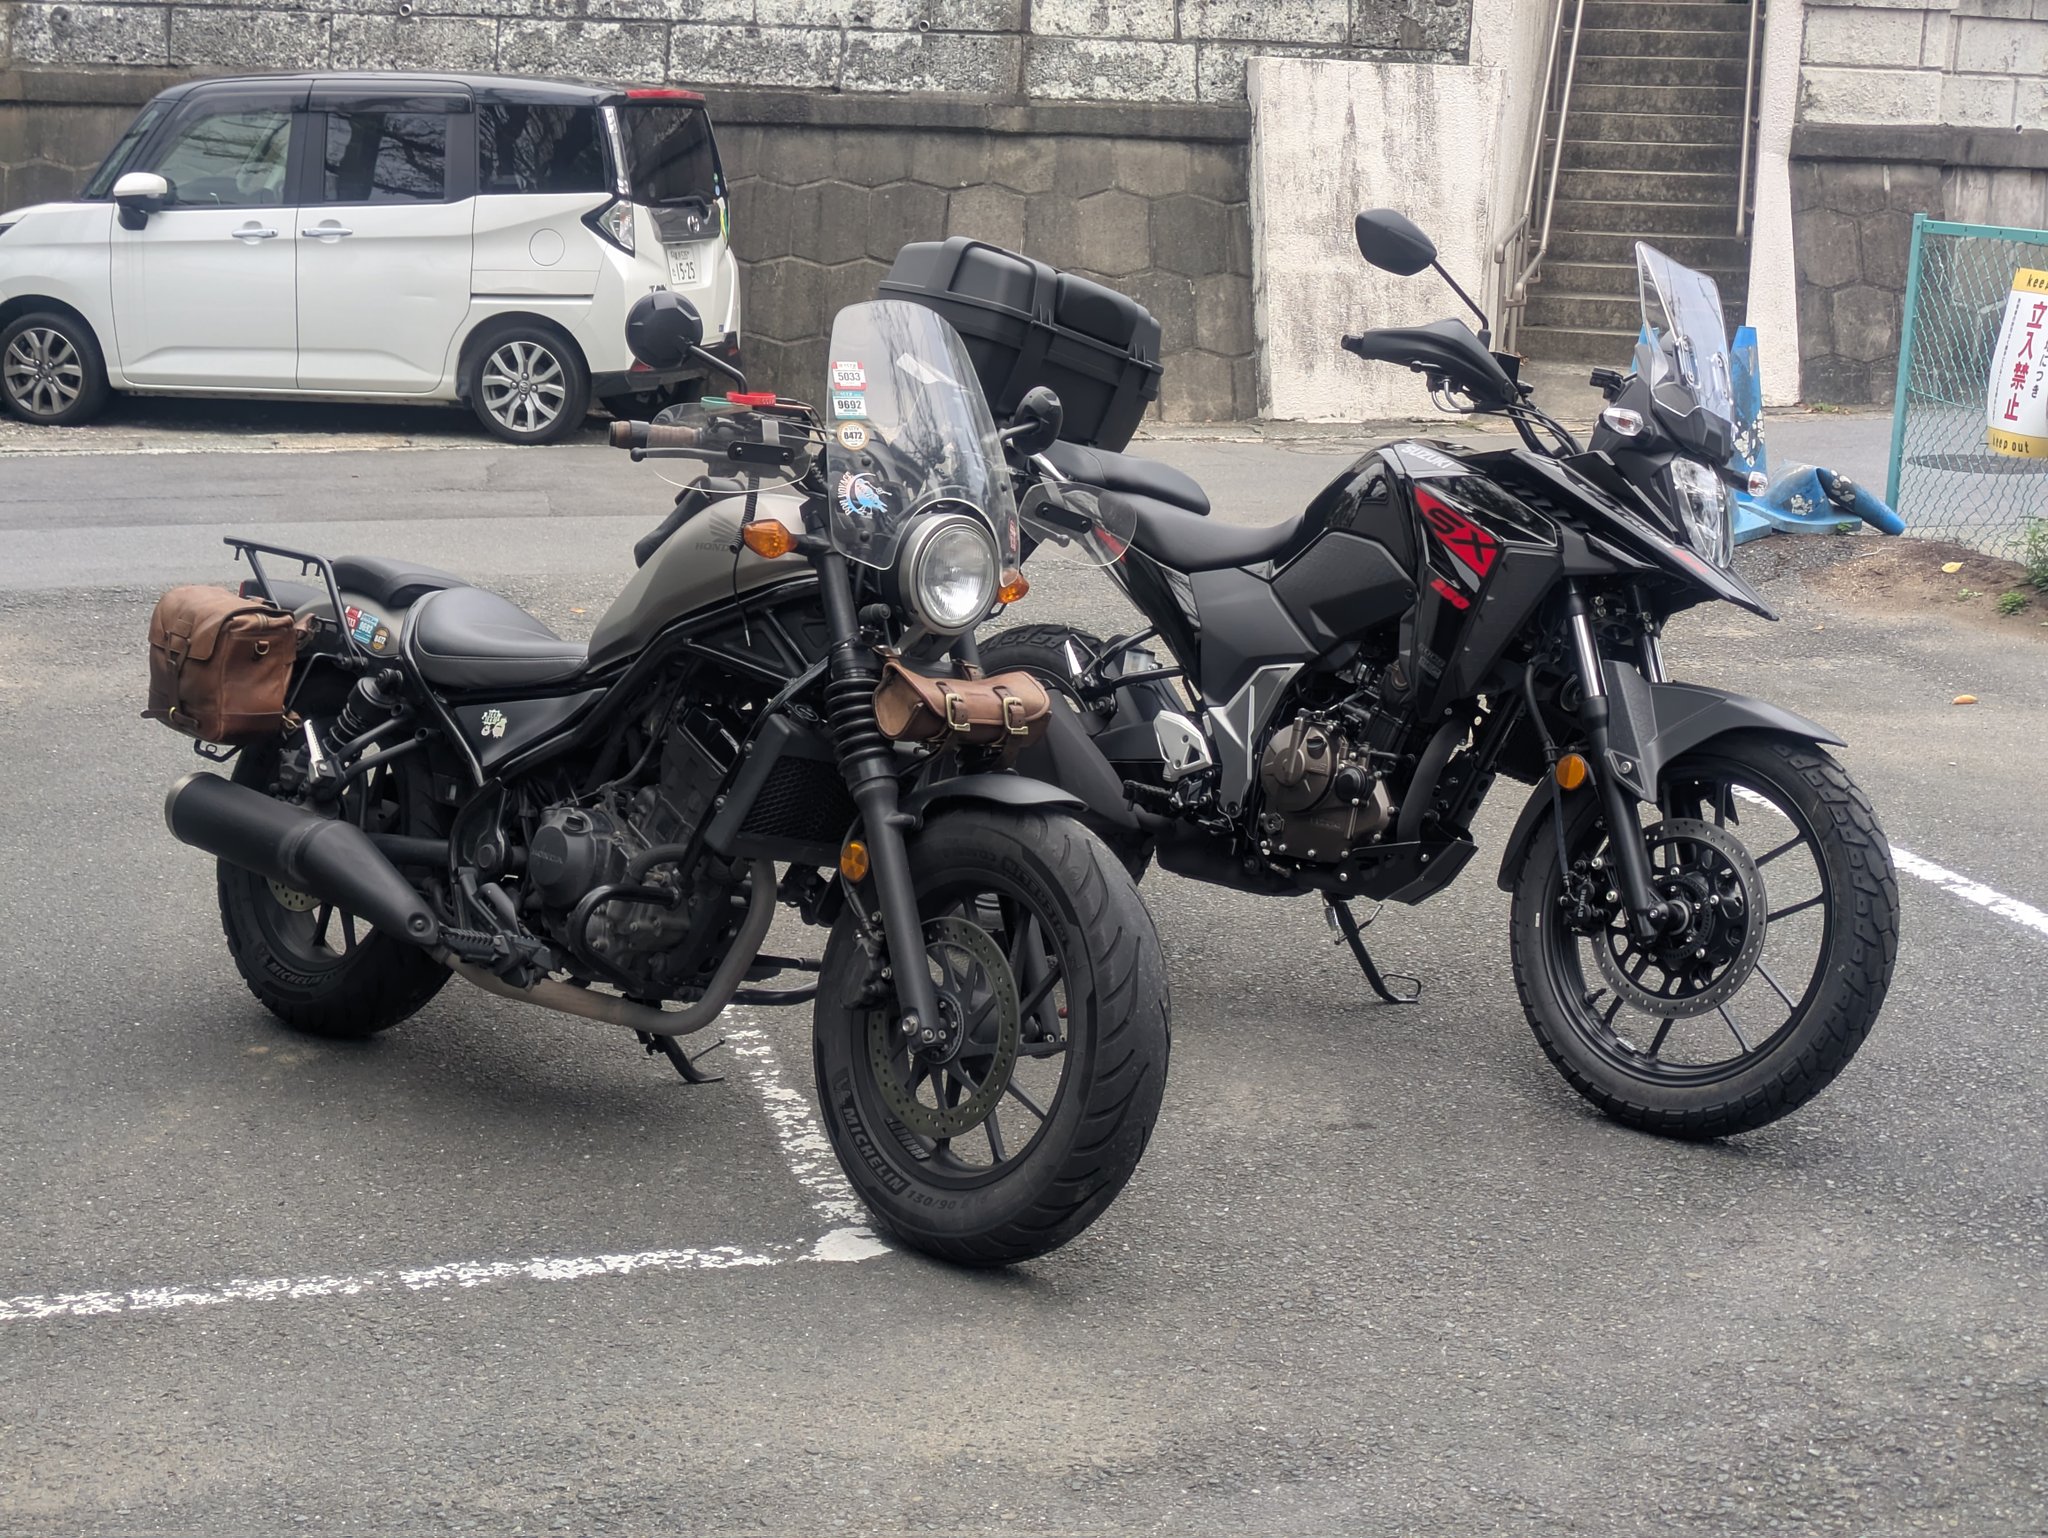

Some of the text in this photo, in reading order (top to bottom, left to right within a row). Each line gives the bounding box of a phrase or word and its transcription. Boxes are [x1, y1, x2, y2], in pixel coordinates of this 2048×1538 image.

[2004, 301, 2048, 421] 立入禁止
[837, 371, 861, 381] 5033
[837, 399, 862, 410] 9692
[2011, 440, 2030, 453] out
[1402, 444, 1456, 469] SUZUKI
[1428, 507, 1499, 564] SX
[695, 541, 731, 553] HOND
[843, 1107, 906, 1193] MICHELIN
